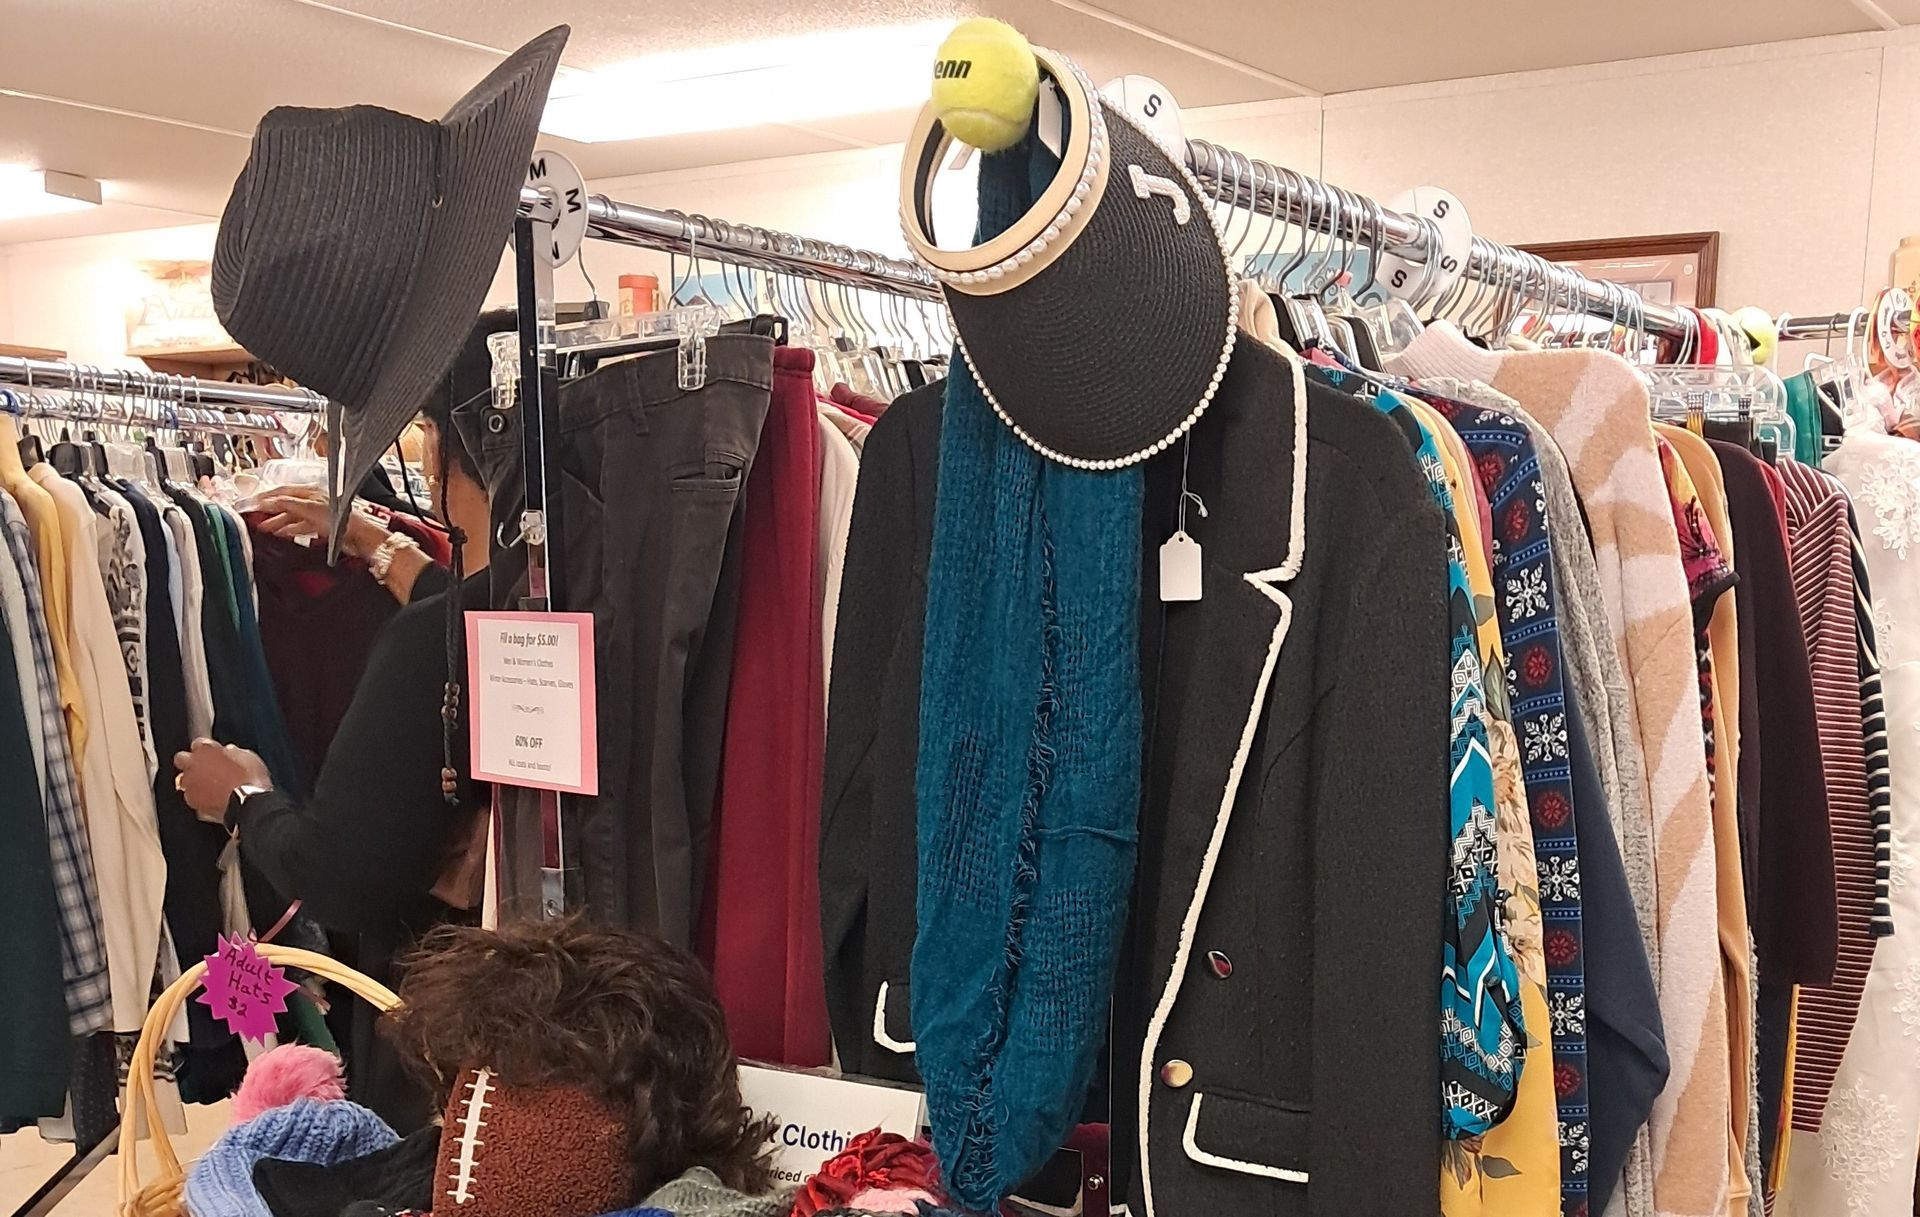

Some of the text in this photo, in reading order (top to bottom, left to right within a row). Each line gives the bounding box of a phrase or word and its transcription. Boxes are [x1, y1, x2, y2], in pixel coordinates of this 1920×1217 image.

[933, 59, 972, 79] enn
[1143, 93, 1162, 118] S
[529, 158, 547, 181] M
[565, 188, 581, 213] M
[1433, 199, 1450, 218] S
[1441, 255, 1458, 273] S
[1391, 269, 1407, 288] S
[499, 631, 508, 644] Fill
[513, 633, 525, 648] bag
[525, 633, 536, 648] for
[536, 633, 559, 648] $5.00!
[515, 734, 543, 749] 60% OFF
[224, 947, 274, 985] Adult
[228, 970, 273, 1005] Hats
[227, 996, 248, 1018] $2
[782, 1123, 851, 1153] Clothi
[768, 1168, 802, 1183] riced
